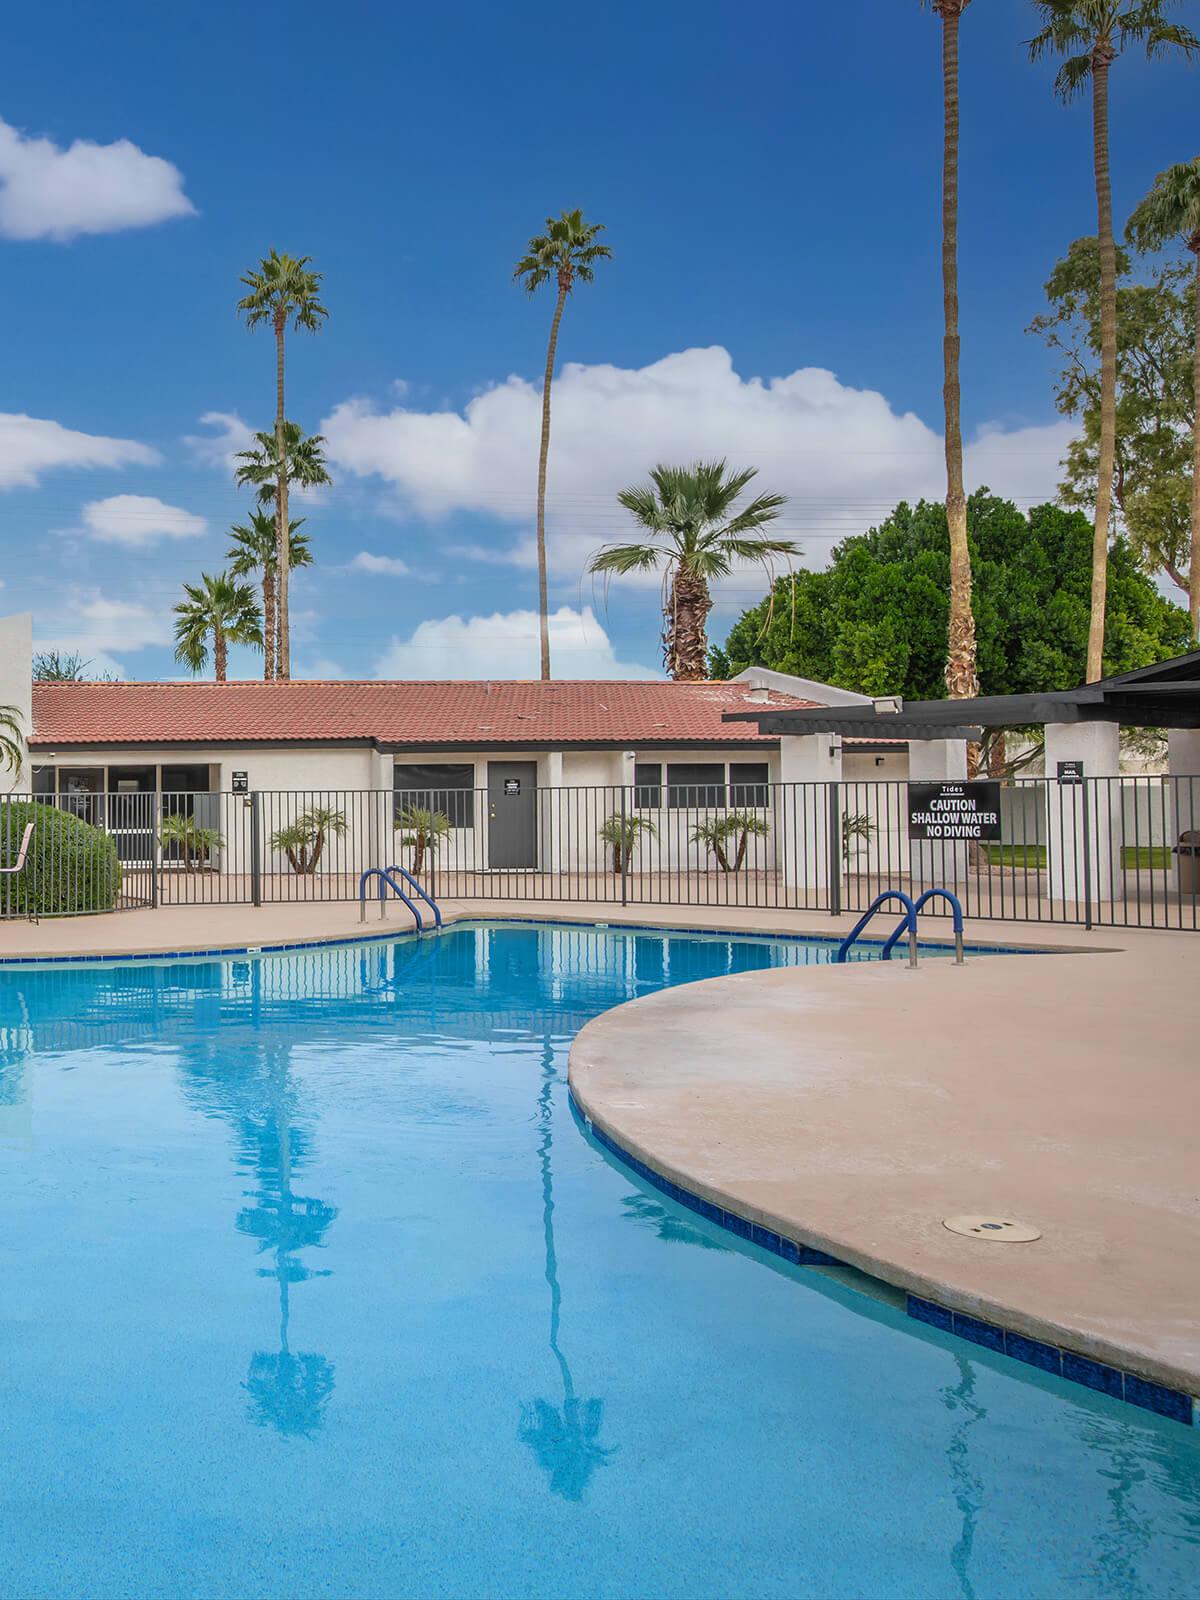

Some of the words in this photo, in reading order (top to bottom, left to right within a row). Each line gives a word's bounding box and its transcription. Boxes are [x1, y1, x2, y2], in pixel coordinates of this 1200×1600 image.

[930, 799, 976, 811] CAUTION
[911, 812, 959, 824] SHALLOW
[961, 812, 997, 824] WATER
[926, 826, 942, 837] NO
[943, 826, 981, 837] DIVING
